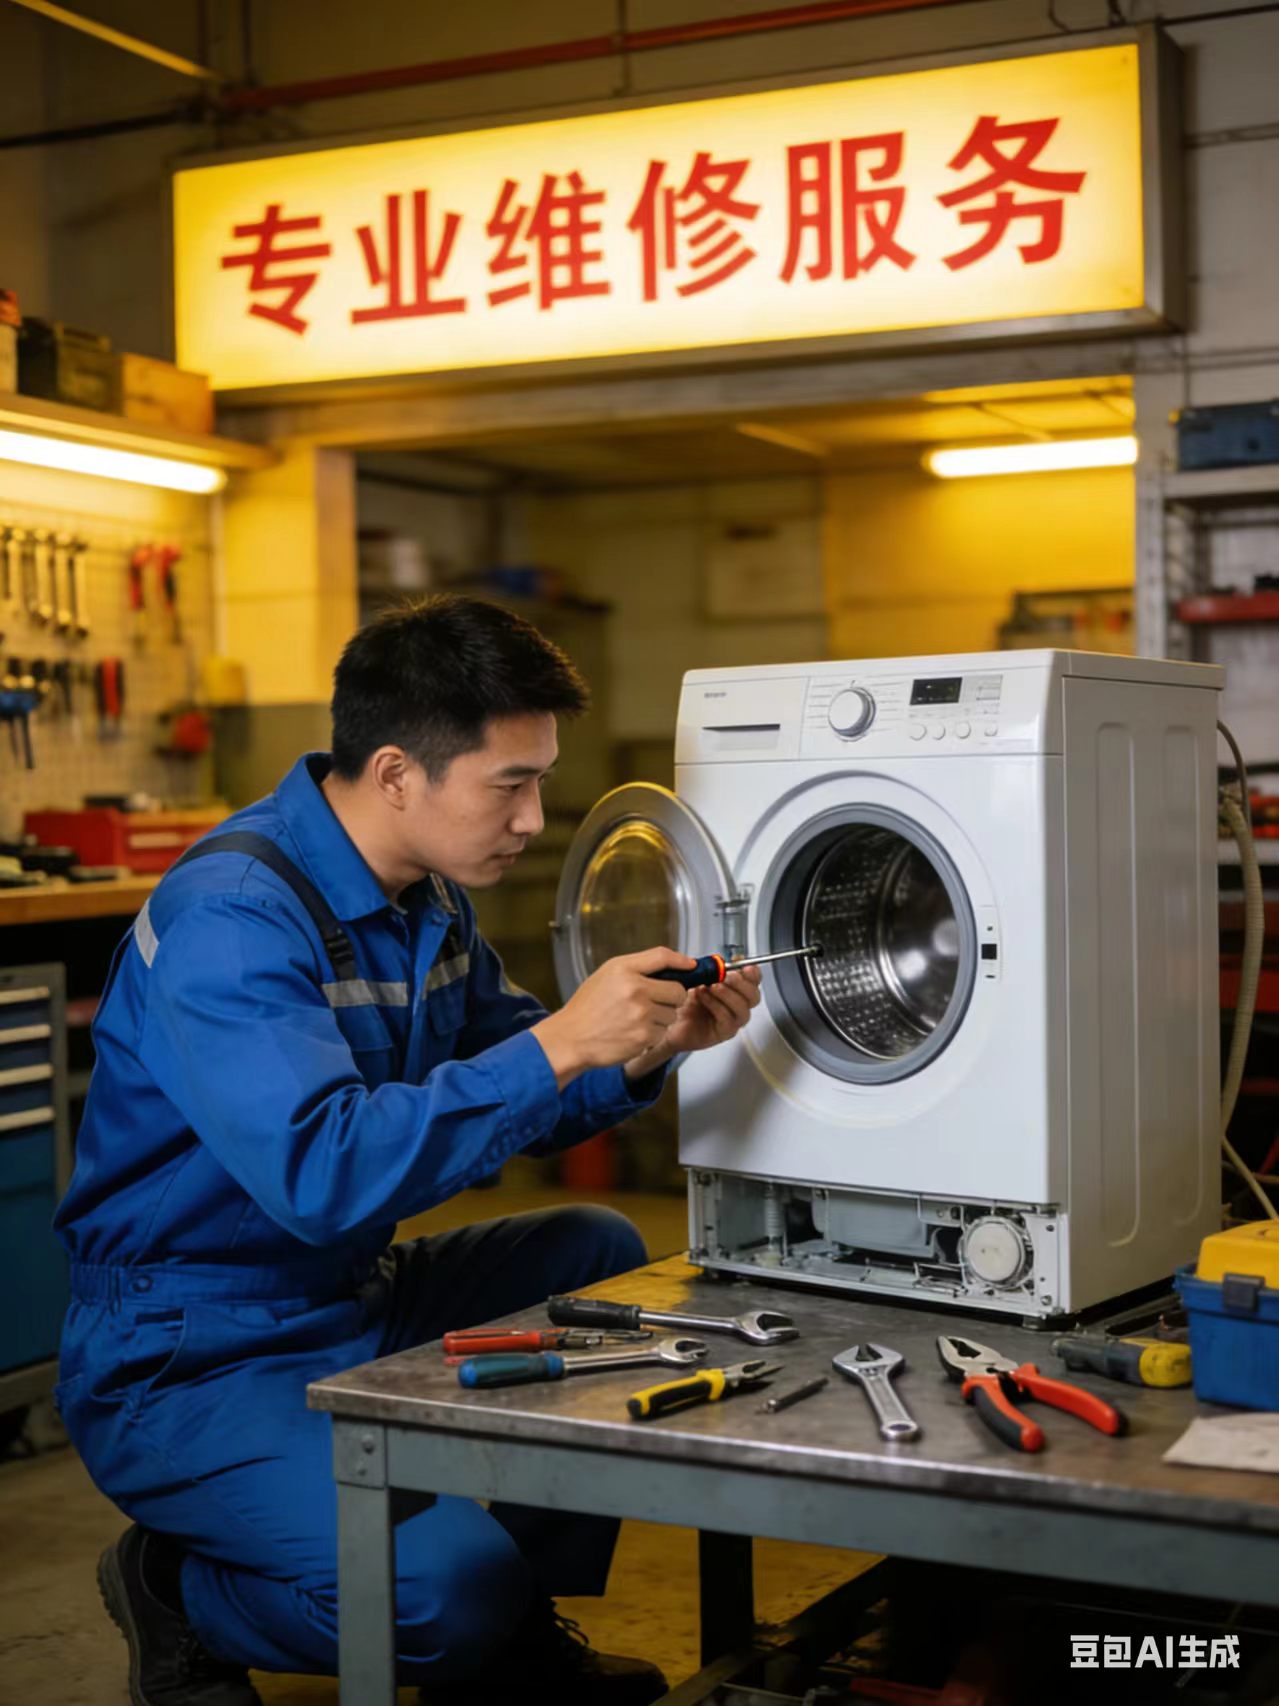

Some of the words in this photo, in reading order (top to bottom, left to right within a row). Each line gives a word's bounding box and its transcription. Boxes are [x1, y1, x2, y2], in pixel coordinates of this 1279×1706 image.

[221, 115, 1086, 335] 专业维修服务
